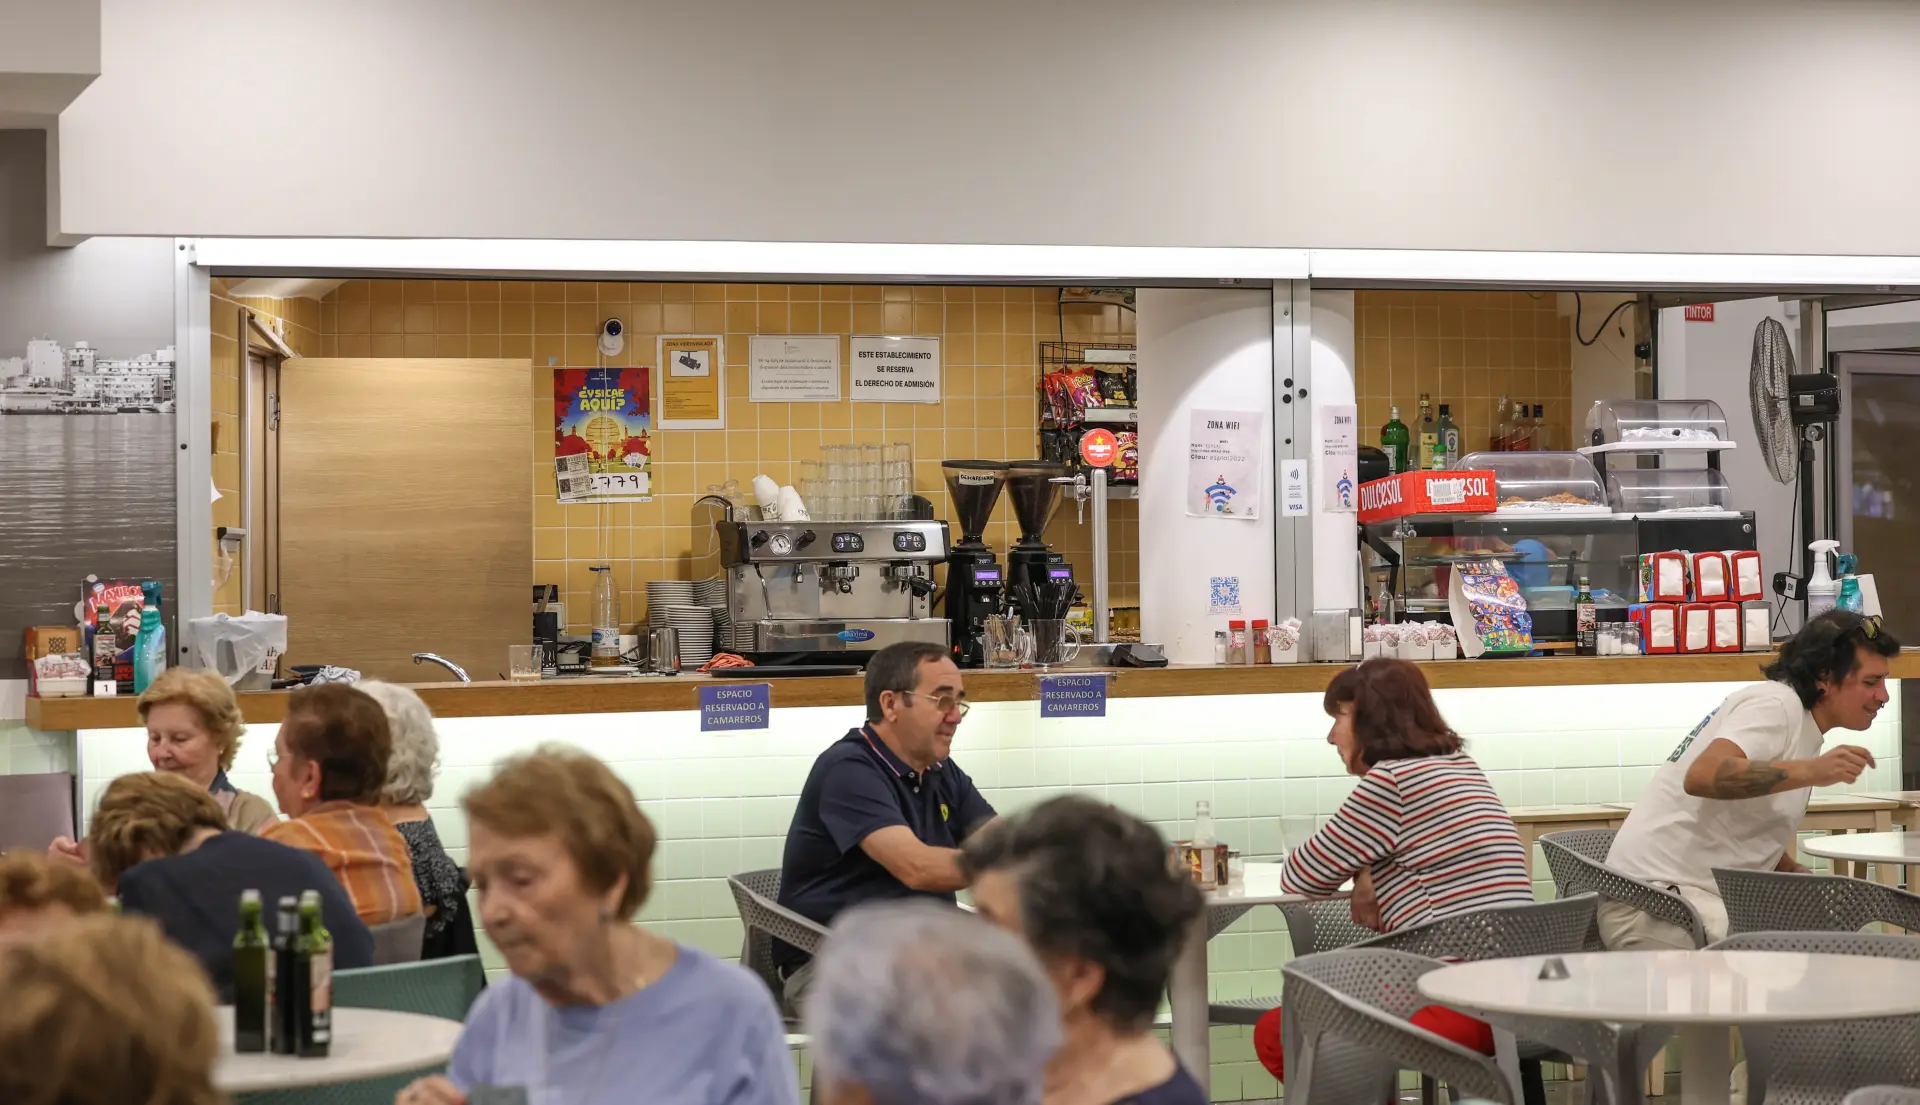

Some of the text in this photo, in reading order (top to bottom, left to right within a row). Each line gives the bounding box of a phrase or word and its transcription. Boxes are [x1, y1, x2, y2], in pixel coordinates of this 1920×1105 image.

[875, 351, 932, 360] ESTABLECIMIENTO
[876, 365, 884, 373] SE
[855, 379, 863, 387] EL
[863, 379, 894, 387] DERECHO
[903, 379, 935, 388] ADMISIÓN
[605, 388, 625, 398] CAE
[580, 395, 626, 412] AQUÍ?
[1207, 420, 1240, 430] ZONA WIFI
[1334, 416, 1343, 425] ZONA
[1057, 678, 1091, 687] ESPACIO
[103, 684, 108, 692] 1
[716, 690, 752, 699] ESPACIO
[1045, 691, 1094, 699] RESERVADO
[705, 702, 765, 712] RESERVADO A
[1047, 703, 1099, 712] CAMAREROS
[707, 715, 762, 725] CAMAREROS
